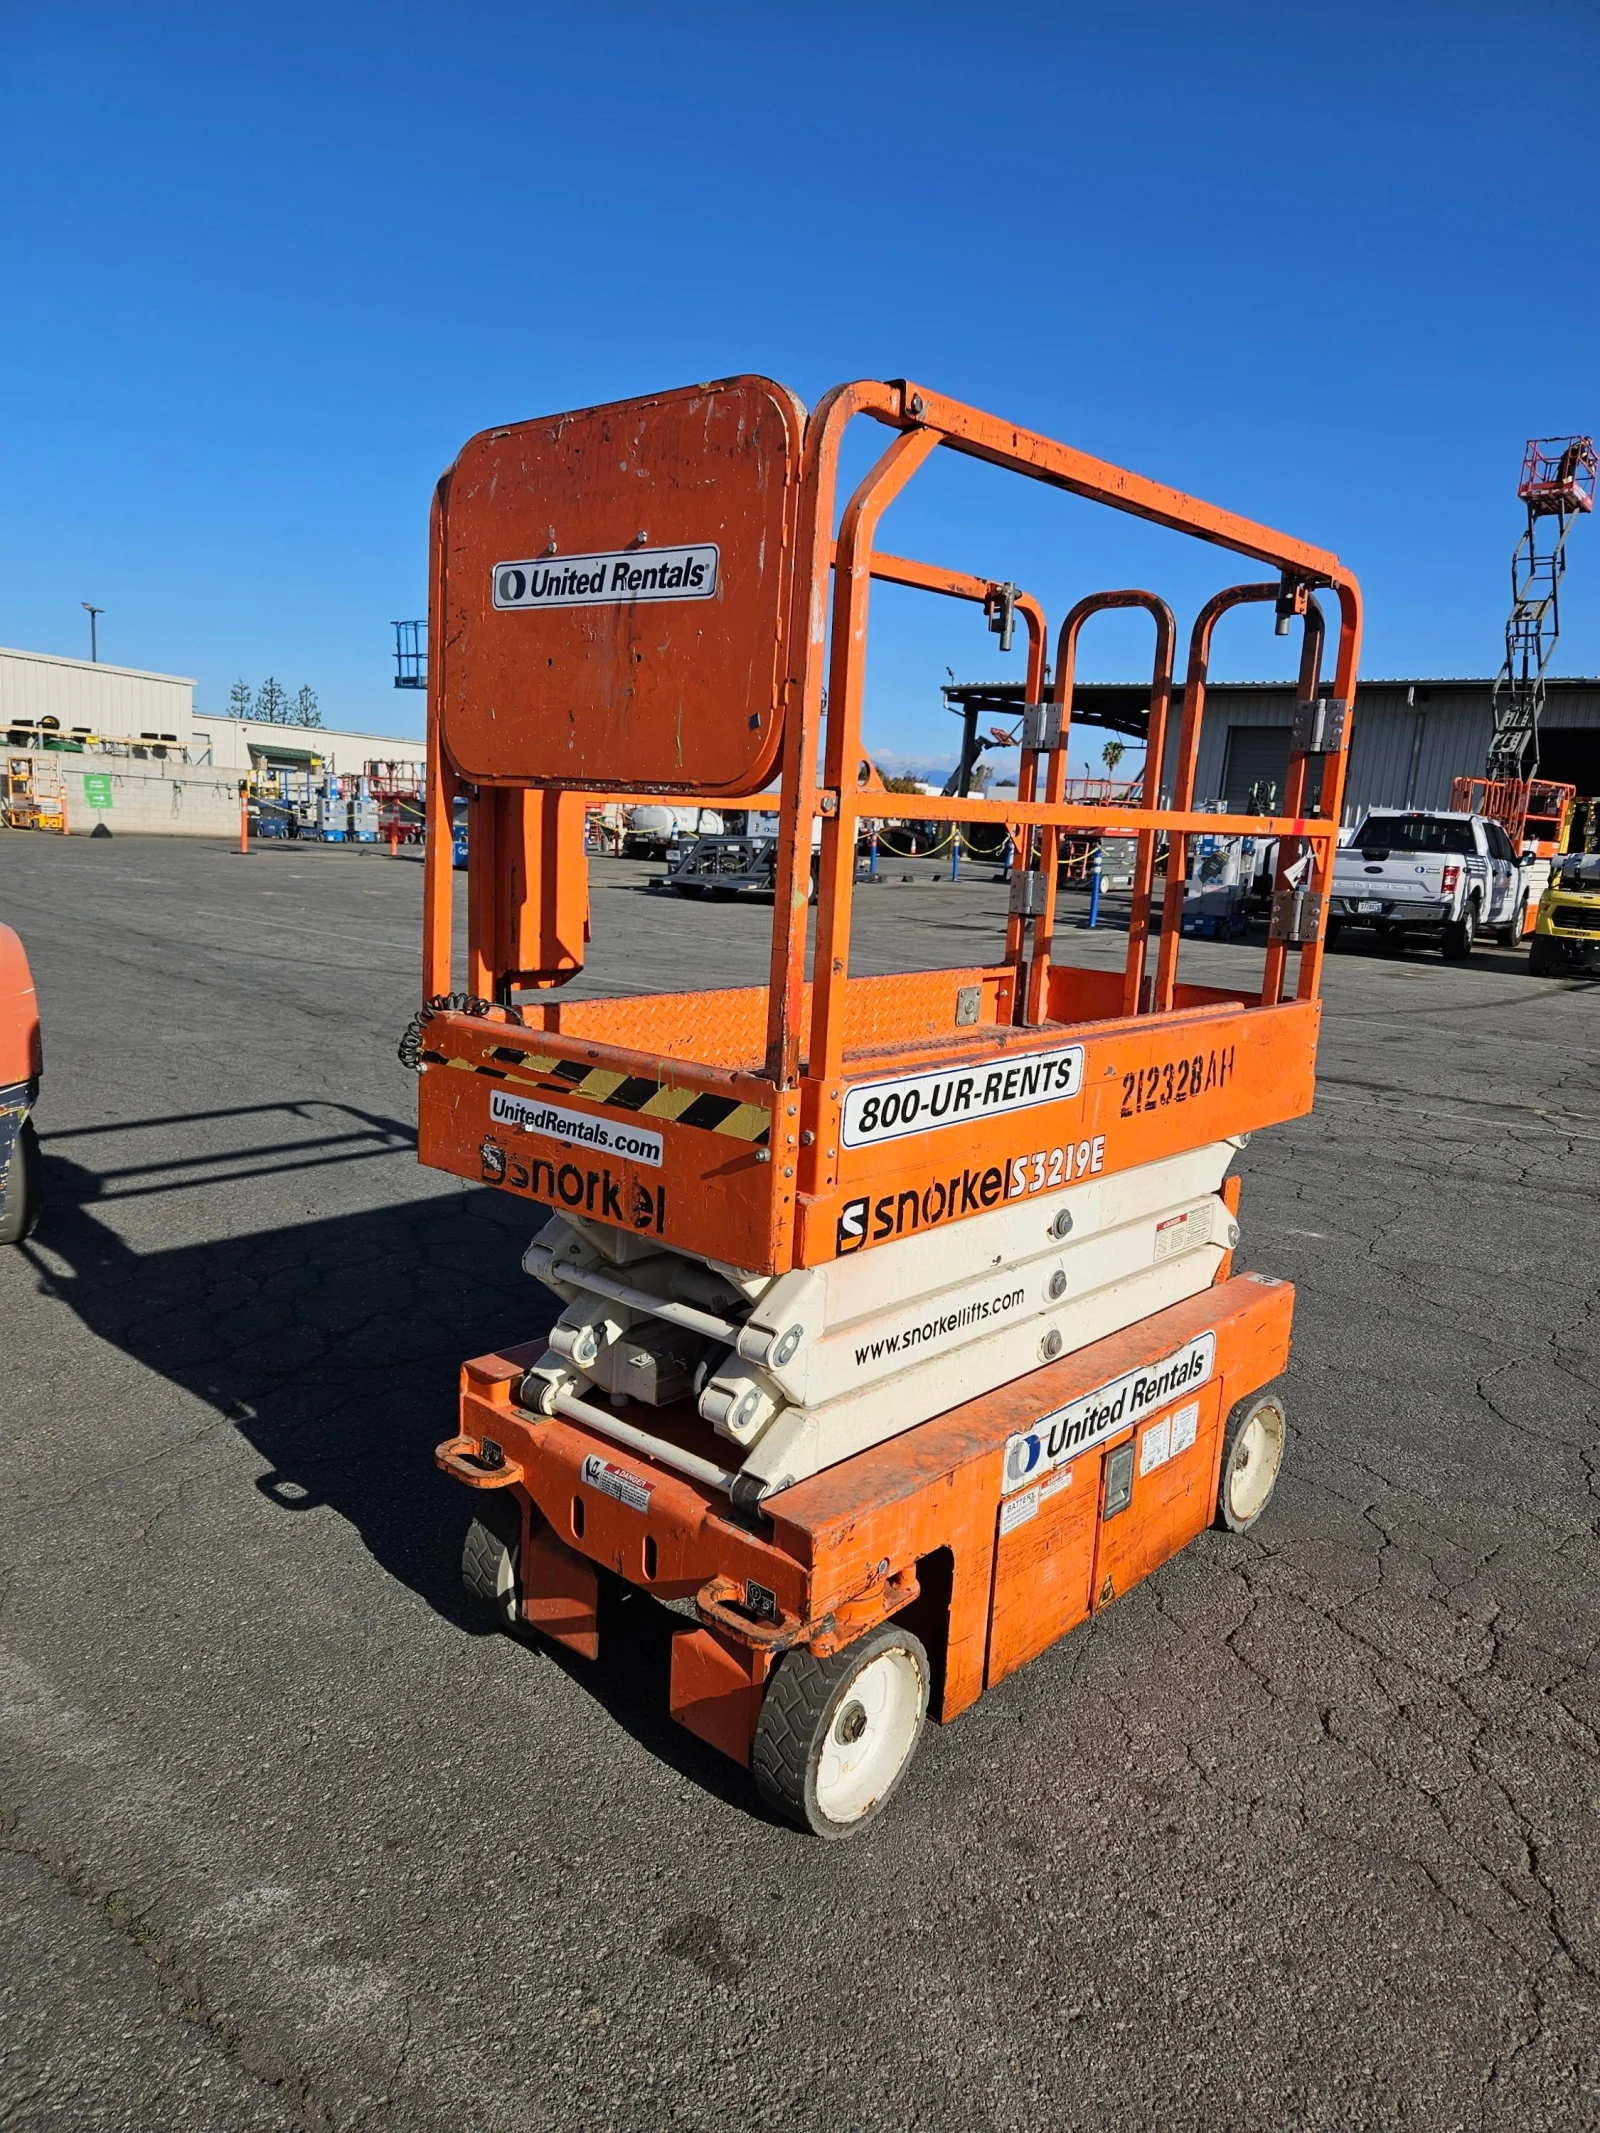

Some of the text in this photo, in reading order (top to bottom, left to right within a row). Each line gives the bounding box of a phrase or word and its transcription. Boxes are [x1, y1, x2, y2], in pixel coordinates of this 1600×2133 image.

[530, 556, 705, 598] United Rentals
[858, 1057, 1073, 1133] 800-UR-RENTS
[1120, 1044, 1236, 1119] 212328AH
[492, 1096, 661, 1161] UnitedRentals.com
[873, 1159, 1011, 1241] snorkel
[1009, 1135, 1106, 1200] S3219E
[854, 1287, 1026, 1367] www.snorkellifts.com
[1046, 1388, 1128, 1459] United
[1129, 1350, 1205, 1413] Rentals
[620, 1469, 647, 1488] DANGER
